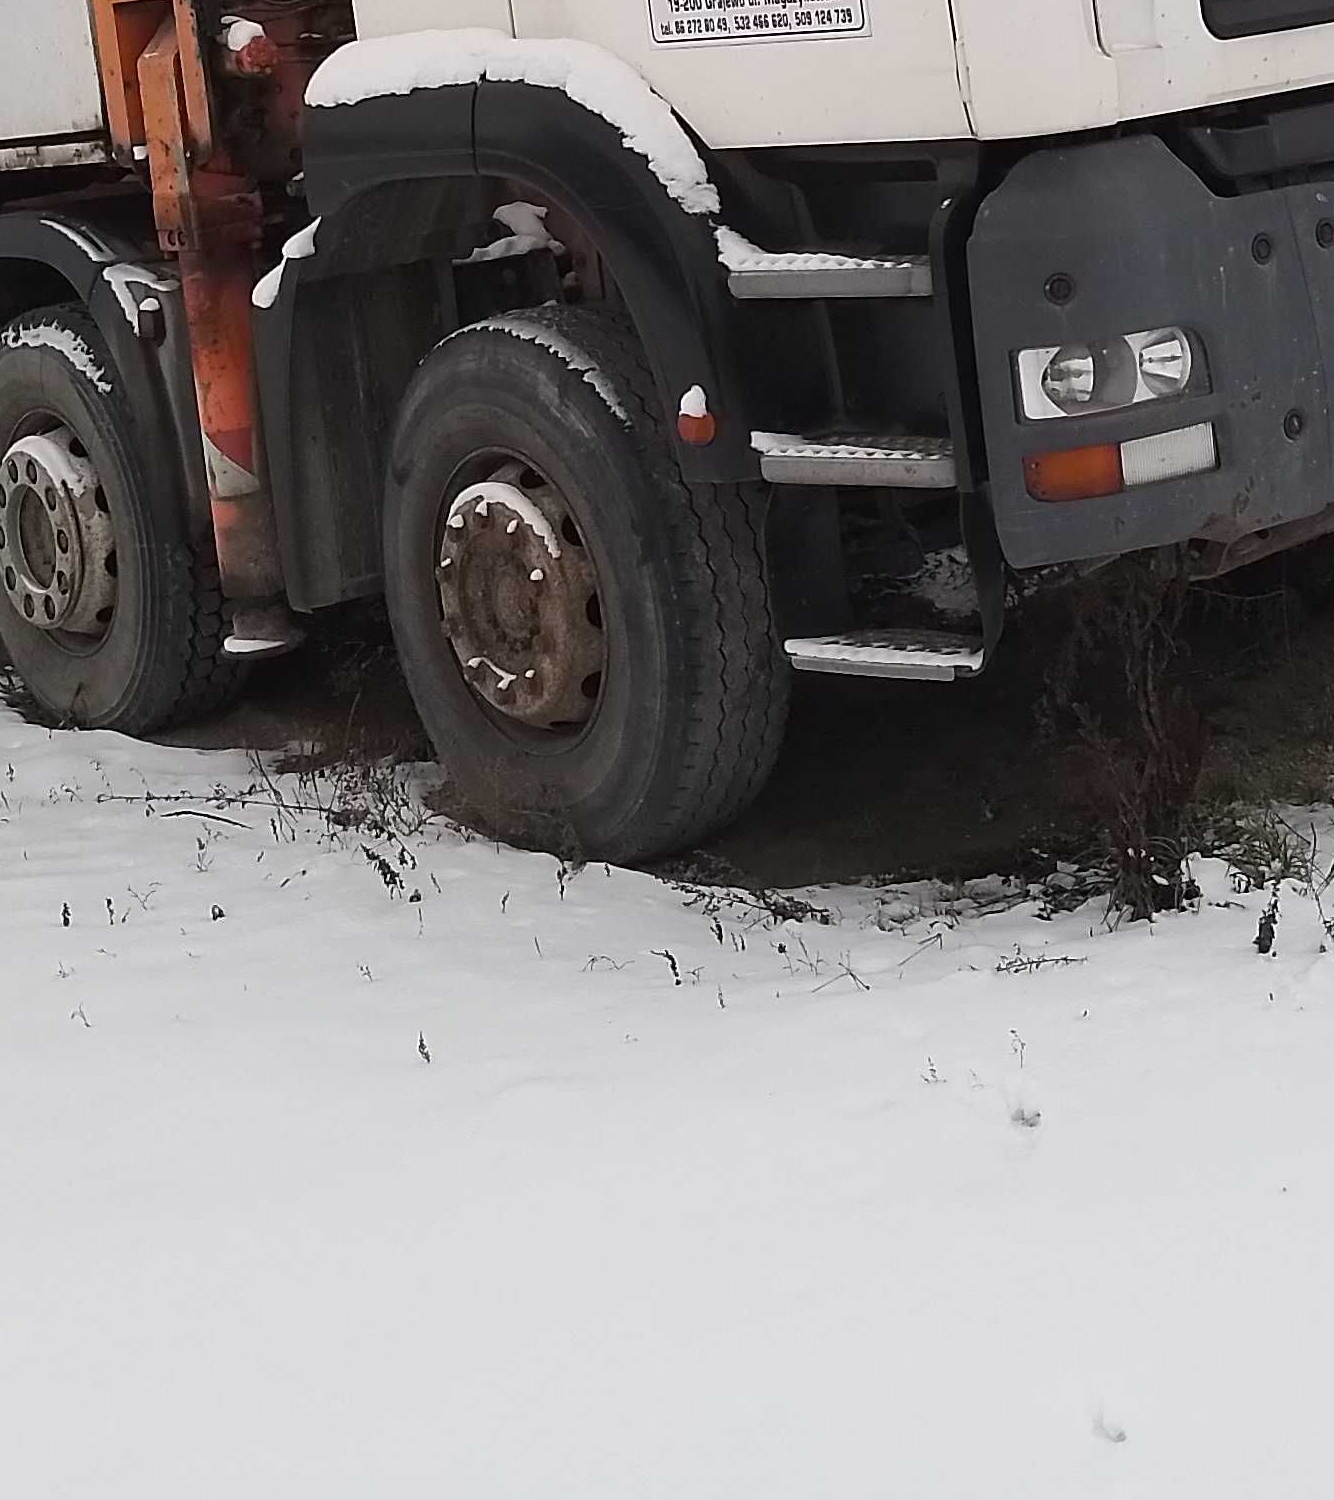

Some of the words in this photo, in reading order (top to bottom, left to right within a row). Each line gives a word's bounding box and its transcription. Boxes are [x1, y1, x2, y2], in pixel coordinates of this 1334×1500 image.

[660, 20, 674, 36] tel.
[686, 18, 703, 34] 272
[716, 17, 732, 35] 49,
[733, 14, 752, 31] 532
[794, 10, 813, 27] 509
[814, 9, 833, 25] 124
[833, 7, 853, 25] 739
